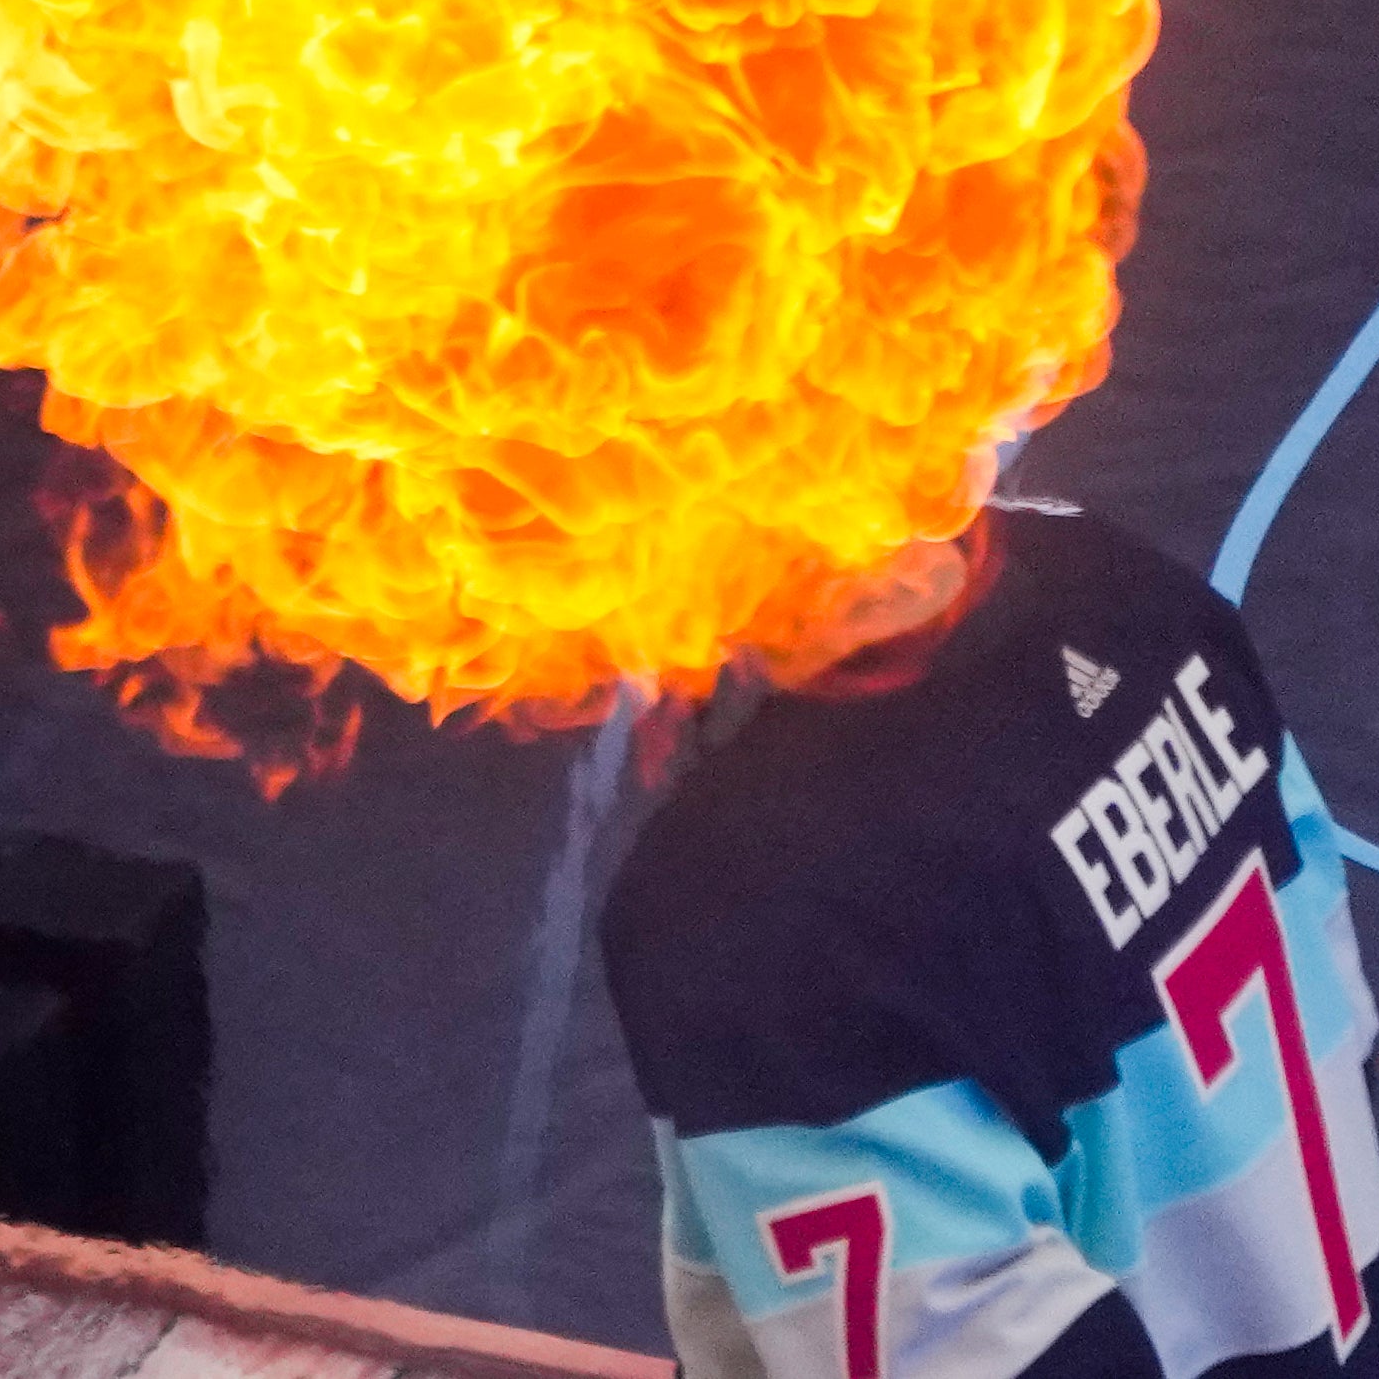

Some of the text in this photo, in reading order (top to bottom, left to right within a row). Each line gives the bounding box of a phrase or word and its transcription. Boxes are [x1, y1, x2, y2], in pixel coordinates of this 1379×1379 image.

[1050, 654, 1270, 951] EBERLE
[1151, 847, 1370, 1365] 7
[755, 1180, 893, 1379] 7
